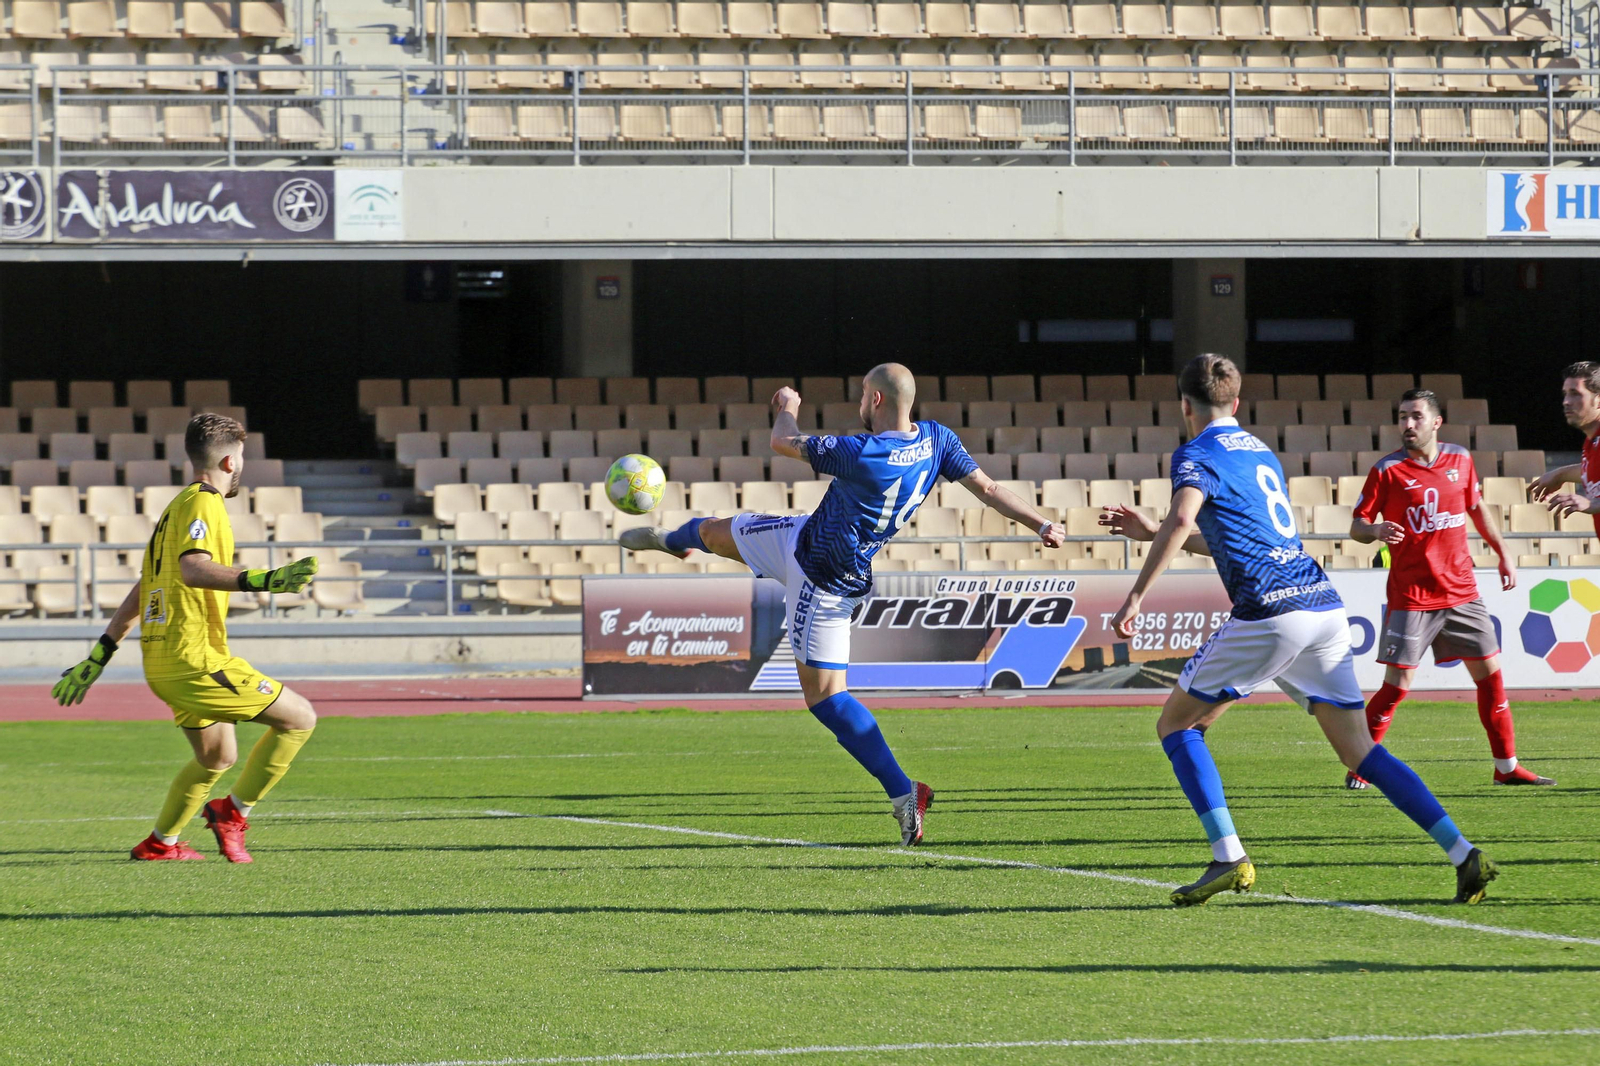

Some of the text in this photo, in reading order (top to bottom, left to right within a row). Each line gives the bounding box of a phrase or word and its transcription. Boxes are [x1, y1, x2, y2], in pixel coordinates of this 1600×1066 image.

[59, 181, 256, 229] Andalucía
[599, 285, 618, 297] 129
[1213, 283, 1231, 294] 129
[873, 470, 928, 533] 16
[1256, 464, 1297, 539] 8
[936, 577, 1077, 595] Grupo Logístico
[1261, 585, 1301, 605] XEREZ
[793, 580, 817, 639] XEREZ
[598, 607, 744, 640] Te Acompañamos
[1134, 612, 1169, 630] 956
[1173, 612, 1205, 630] 270
[626, 639, 648, 657] en
[1132, 632, 1166, 651] 622
[1169, 632, 1202, 650] 064
